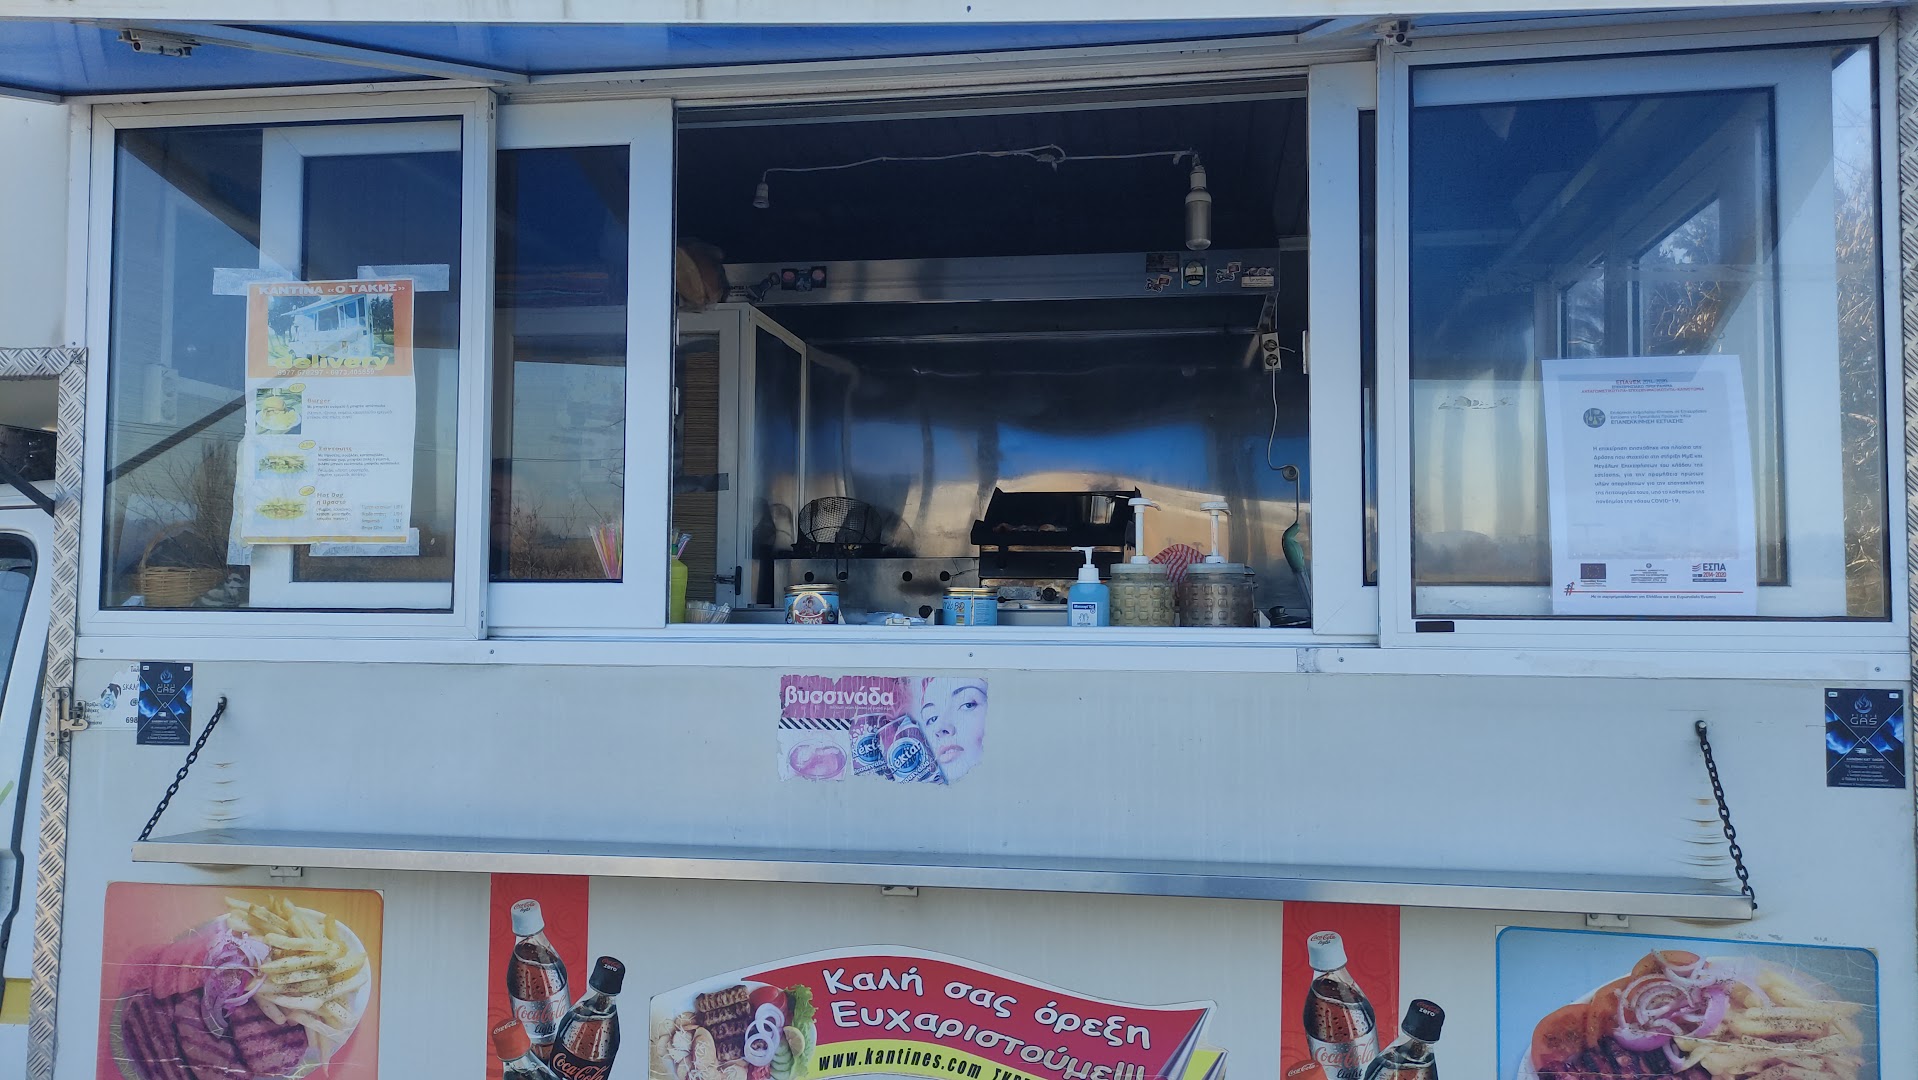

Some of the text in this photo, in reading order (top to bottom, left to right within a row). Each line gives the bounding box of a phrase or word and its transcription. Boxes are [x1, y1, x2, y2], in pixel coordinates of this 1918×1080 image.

[259, 285, 323, 295] ΚΑΝΤΙΝΑ
[275, 354, 389, 370] delivery
[1702, 563, 1727, 571] ΕΣΠΑ
[156, 686, 176, 694] GAS
[784, 686, 895, 707] βυσσινάδα
[1850, 716, 1878, 726] GAS
[603, 963, 618, 972] zero
[822, 966, 1151, 1050] Καλή σας όρεξη
[1418, 1007, 1436, 1017] zero
[818, 1047, 983, 1080] www.kantines.com
